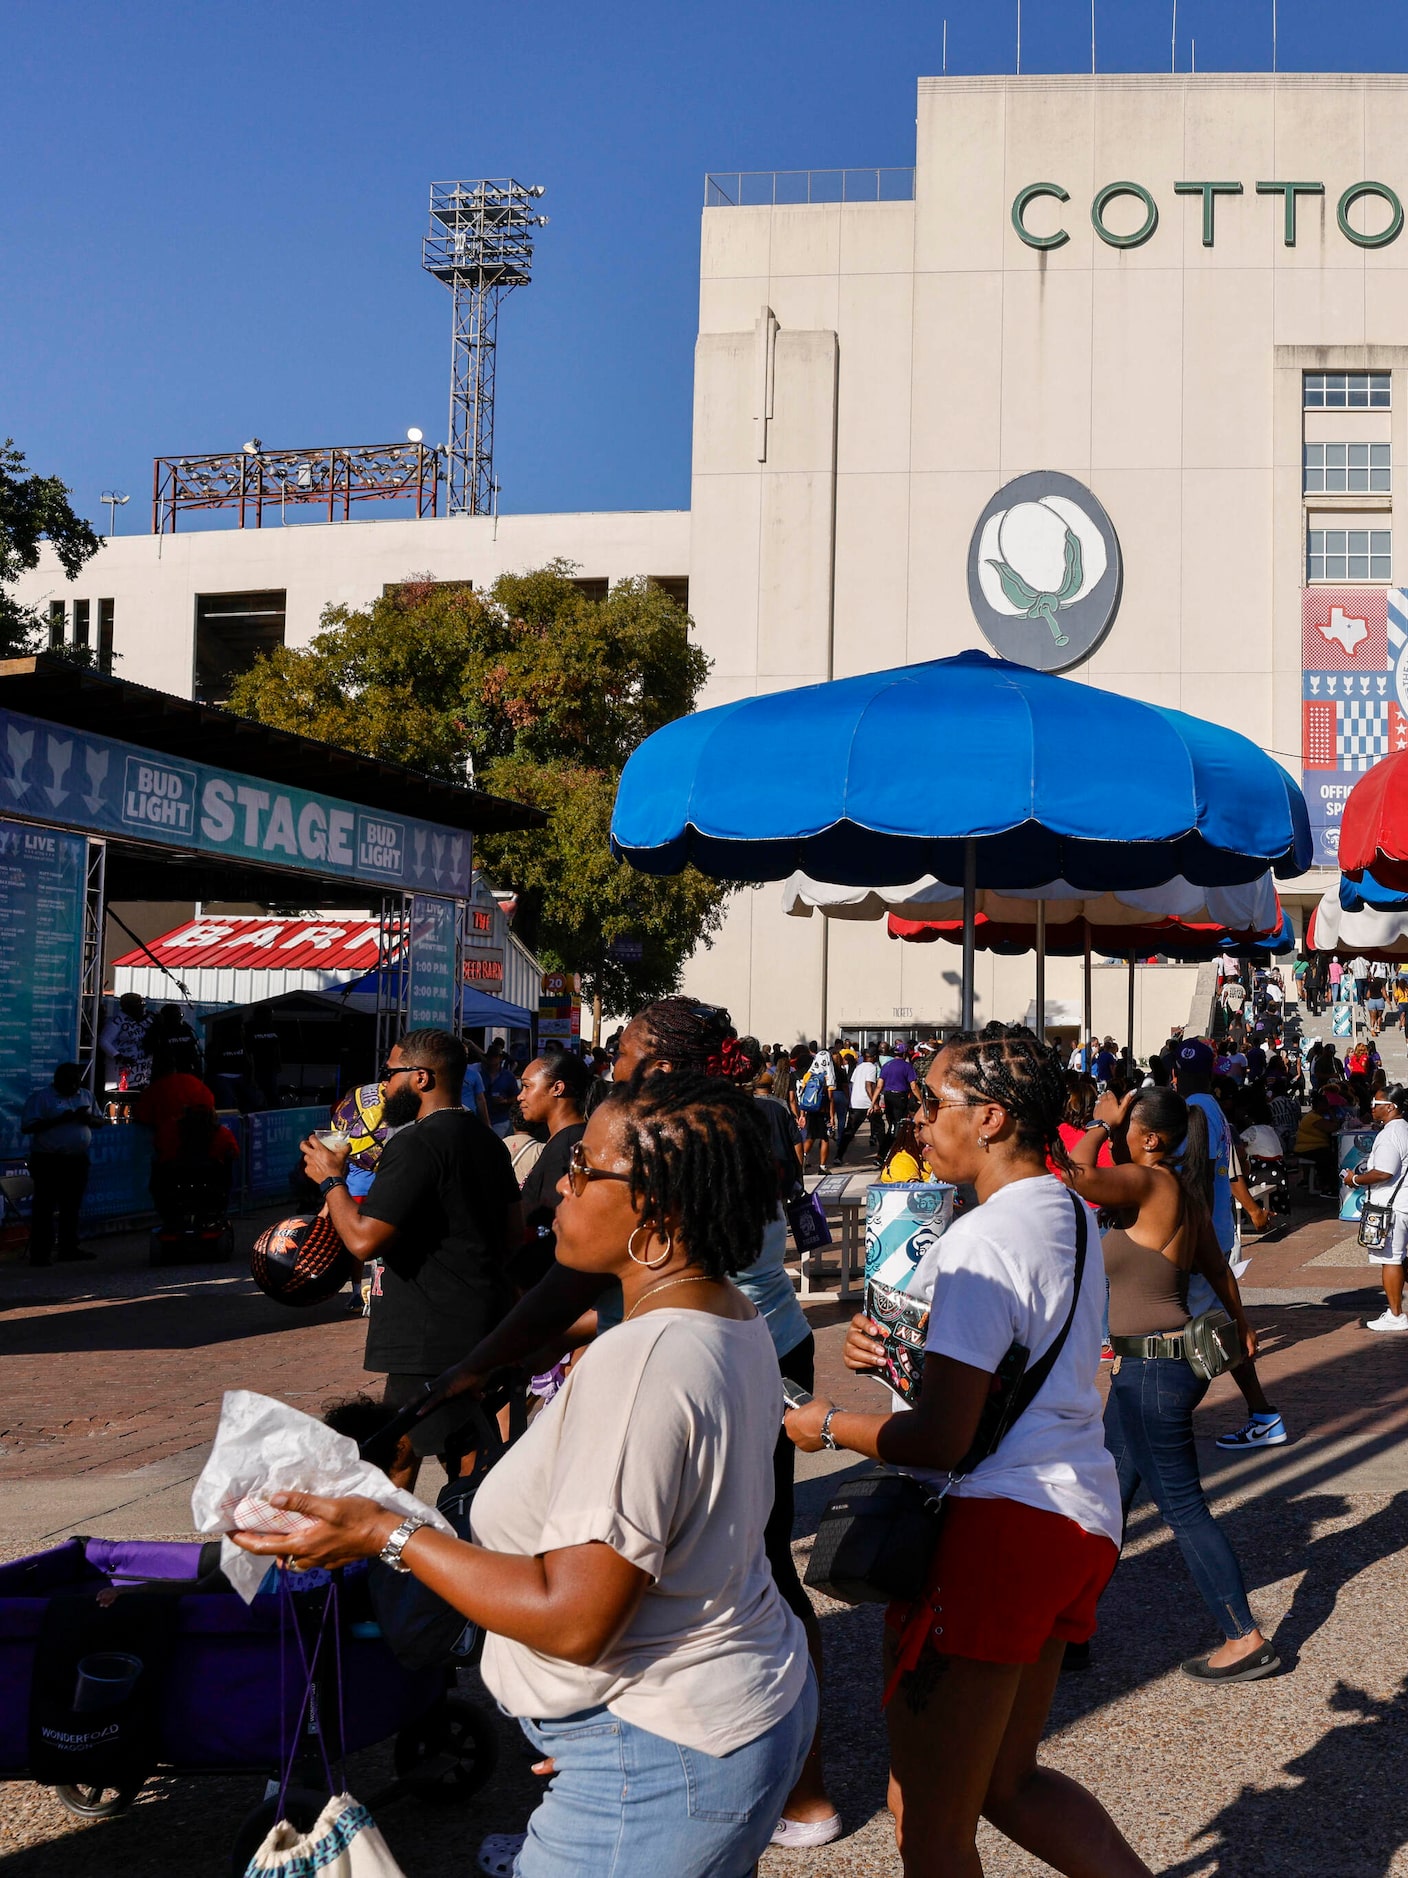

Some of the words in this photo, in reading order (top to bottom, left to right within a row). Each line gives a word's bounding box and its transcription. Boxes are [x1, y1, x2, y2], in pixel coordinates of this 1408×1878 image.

[138, 766, 183, 798] BUD
[126, 792, 190, 830] LIGHT
[200, 778, 355, 866] STAGE
[25, 834, 55, 852] LIVE
[366, 822, 397, 848] BUD
[360, 840, 401, 870] LIGHT
[416, 961, 432, 973] 1:00
[413, 985, 431, 997] 3:00
[548, 978, 563, 989] 20
[412, 1010, 430, 1021] 5:00
[892, 1007, 913, 1018] TICKETS
[41, 1723, 119, 1743] WONDERFOLD
